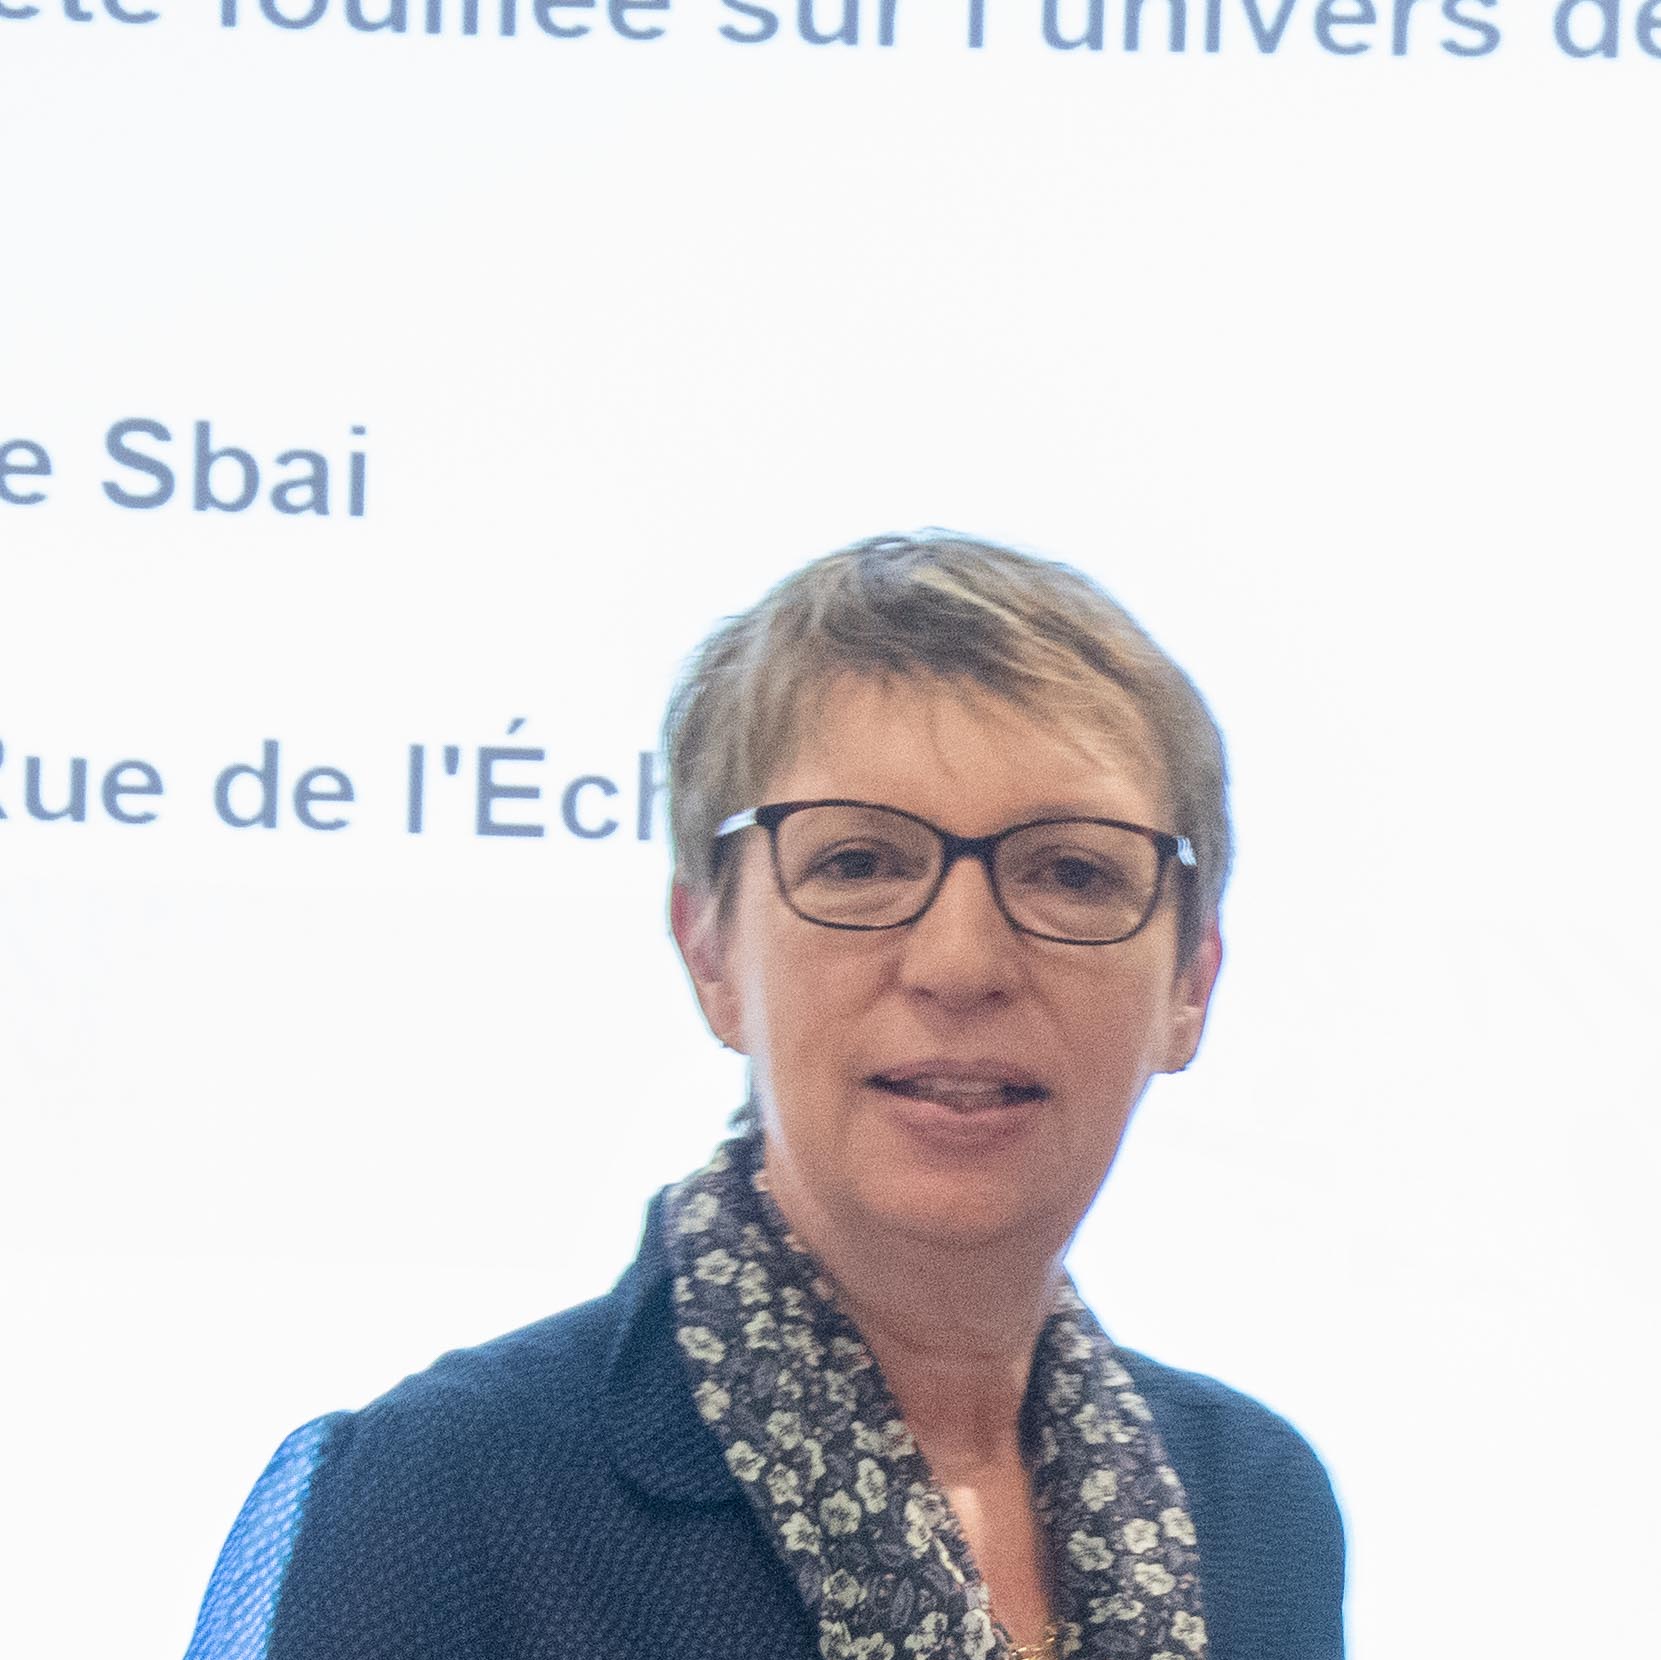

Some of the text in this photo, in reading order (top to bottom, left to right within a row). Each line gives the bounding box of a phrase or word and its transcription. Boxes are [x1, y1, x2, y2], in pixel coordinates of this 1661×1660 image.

[101, 417, 368, 518] Sbai
[0, 739, 164, 825] ue
[213, 738, 355, 832] de
